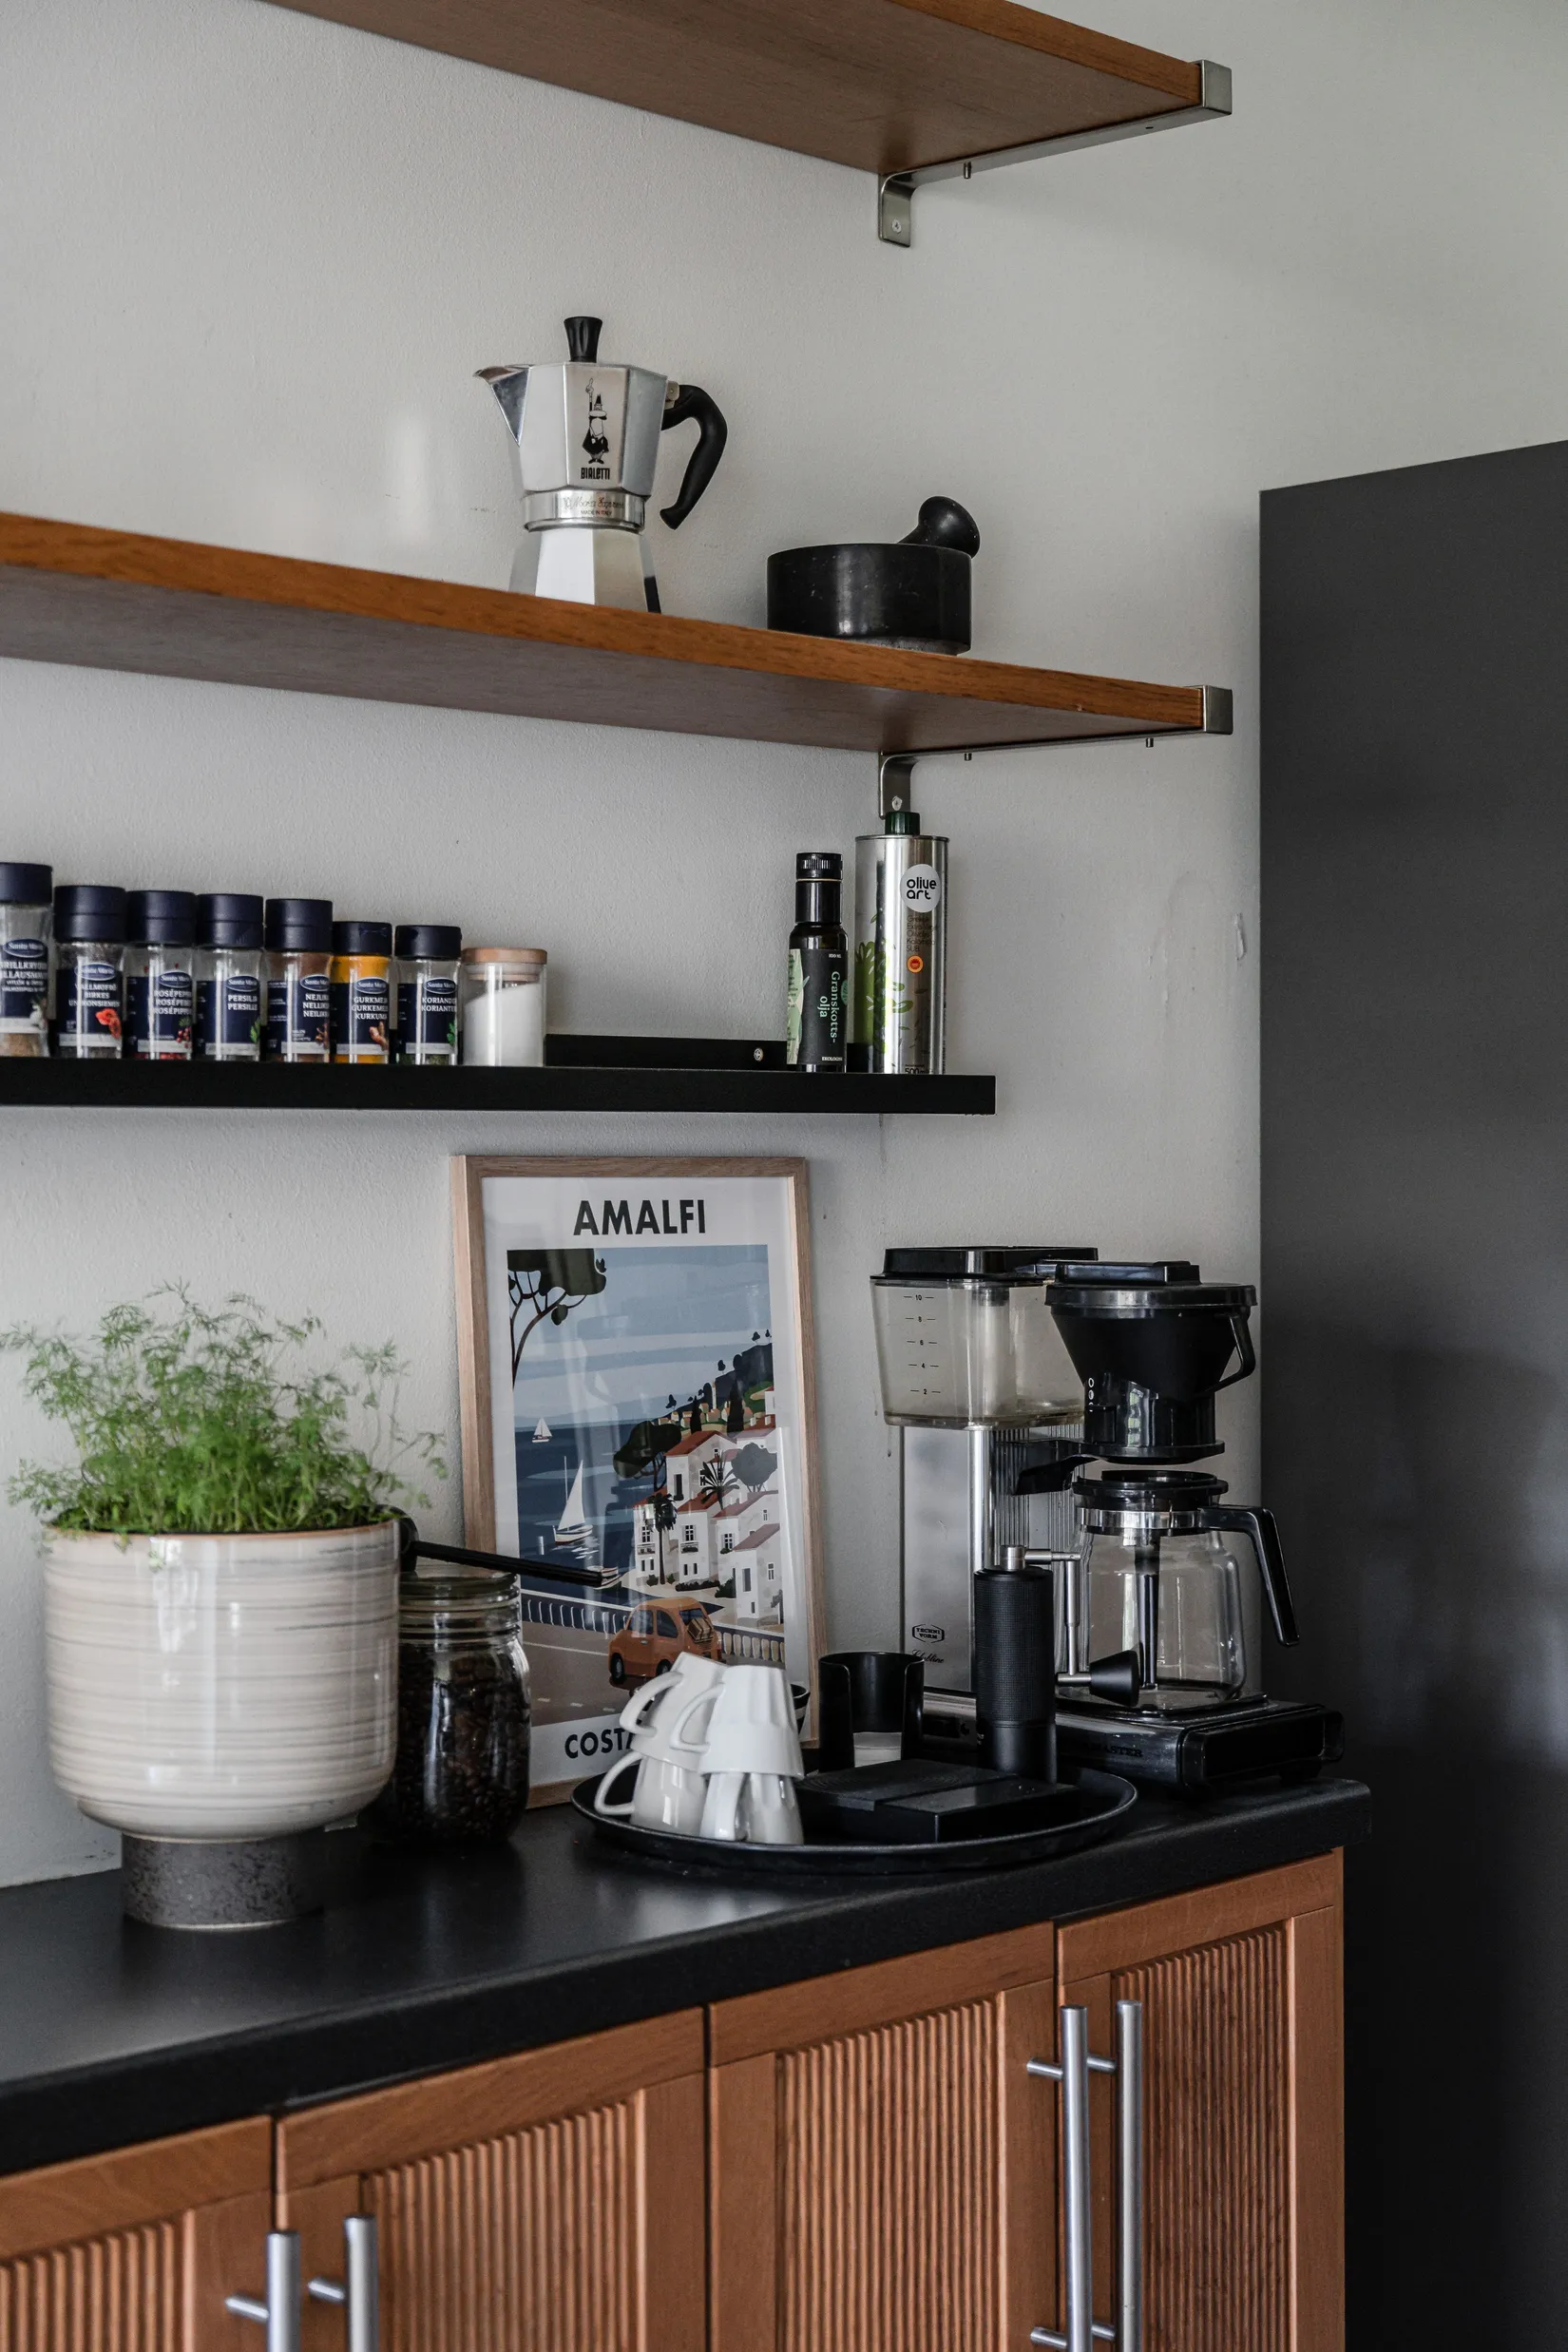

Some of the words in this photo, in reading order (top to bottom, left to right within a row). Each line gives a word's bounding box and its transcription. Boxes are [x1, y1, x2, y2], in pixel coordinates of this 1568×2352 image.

[581, 467, 610, 480] BIALETTI
[906, 876, 937, 889] olive
[906, 889, 931, 900] art
[817, 996, 830, 1018] olja
[830, 971, 841, 1043] Granskotts-
[573, 1199, 706, 1235] AMALFI
